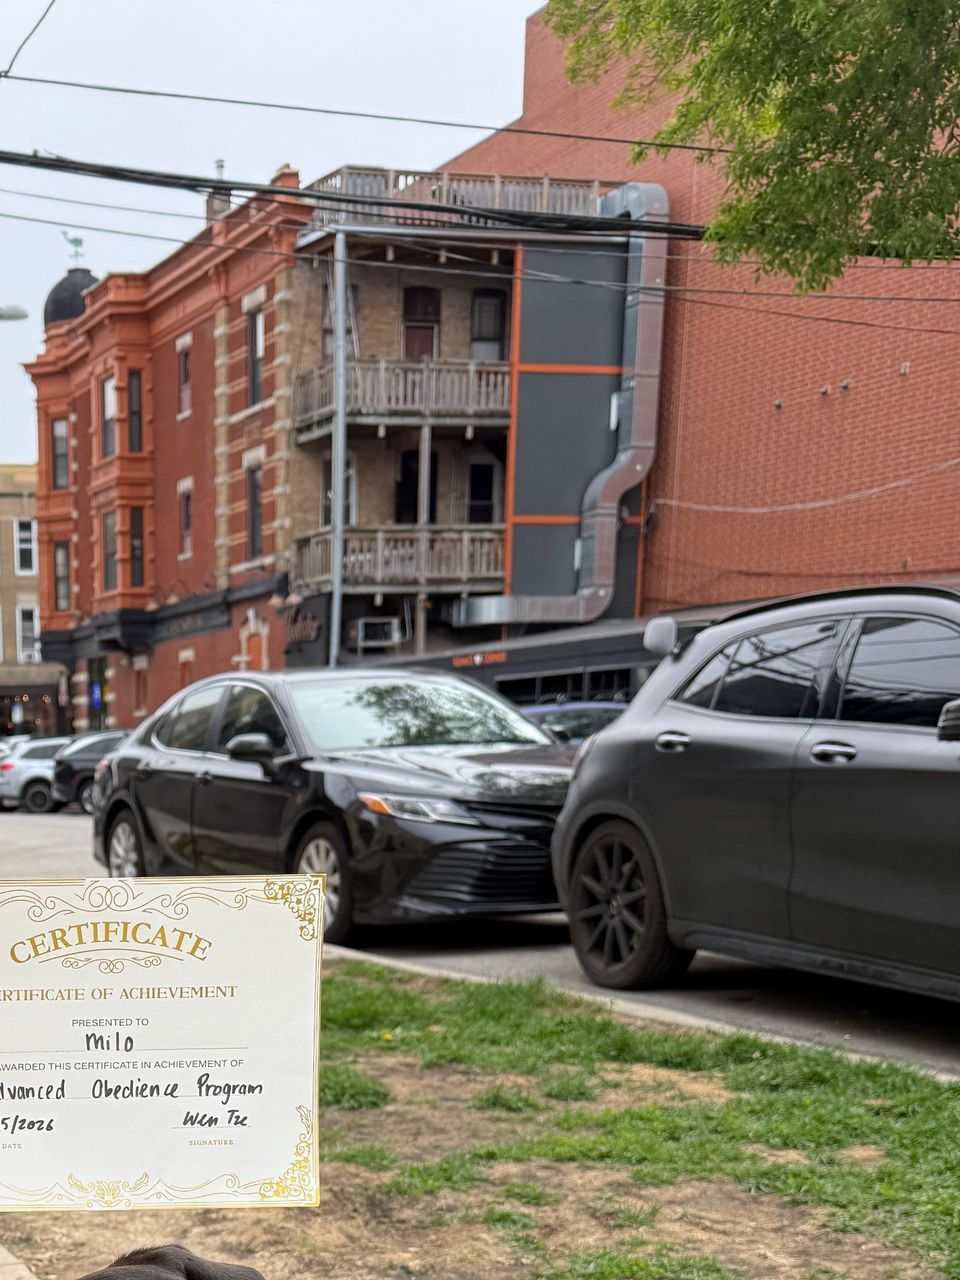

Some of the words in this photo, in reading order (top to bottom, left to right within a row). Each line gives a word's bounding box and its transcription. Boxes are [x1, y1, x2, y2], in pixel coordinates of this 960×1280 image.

[9, 920, 213, 964] CERTIFICATE
[90, 987, 114, 1000] OF
[119, 985, 238, 1000] ACHIEVEMENT
[71, 1018, 133, 1028] PRESENTED
[134, 1017, 150, 1027] TO
[47, 1062, 72, 1071] THIS
[73, 1060, 139, 1071] CERTIFICATE
[140, 1060, 152, 1070] IN
[153, 1059, 228, 1069] ACHIEVEMENT
[229, 1059, 245, 1068] OF
[91, 1077, 179, 1100] Obedience
[196, 1072, 263, 1106] Program
[182, 1111, 219, 1128] Wen
[188, 1138, 234, 1147] SIGNATURE
